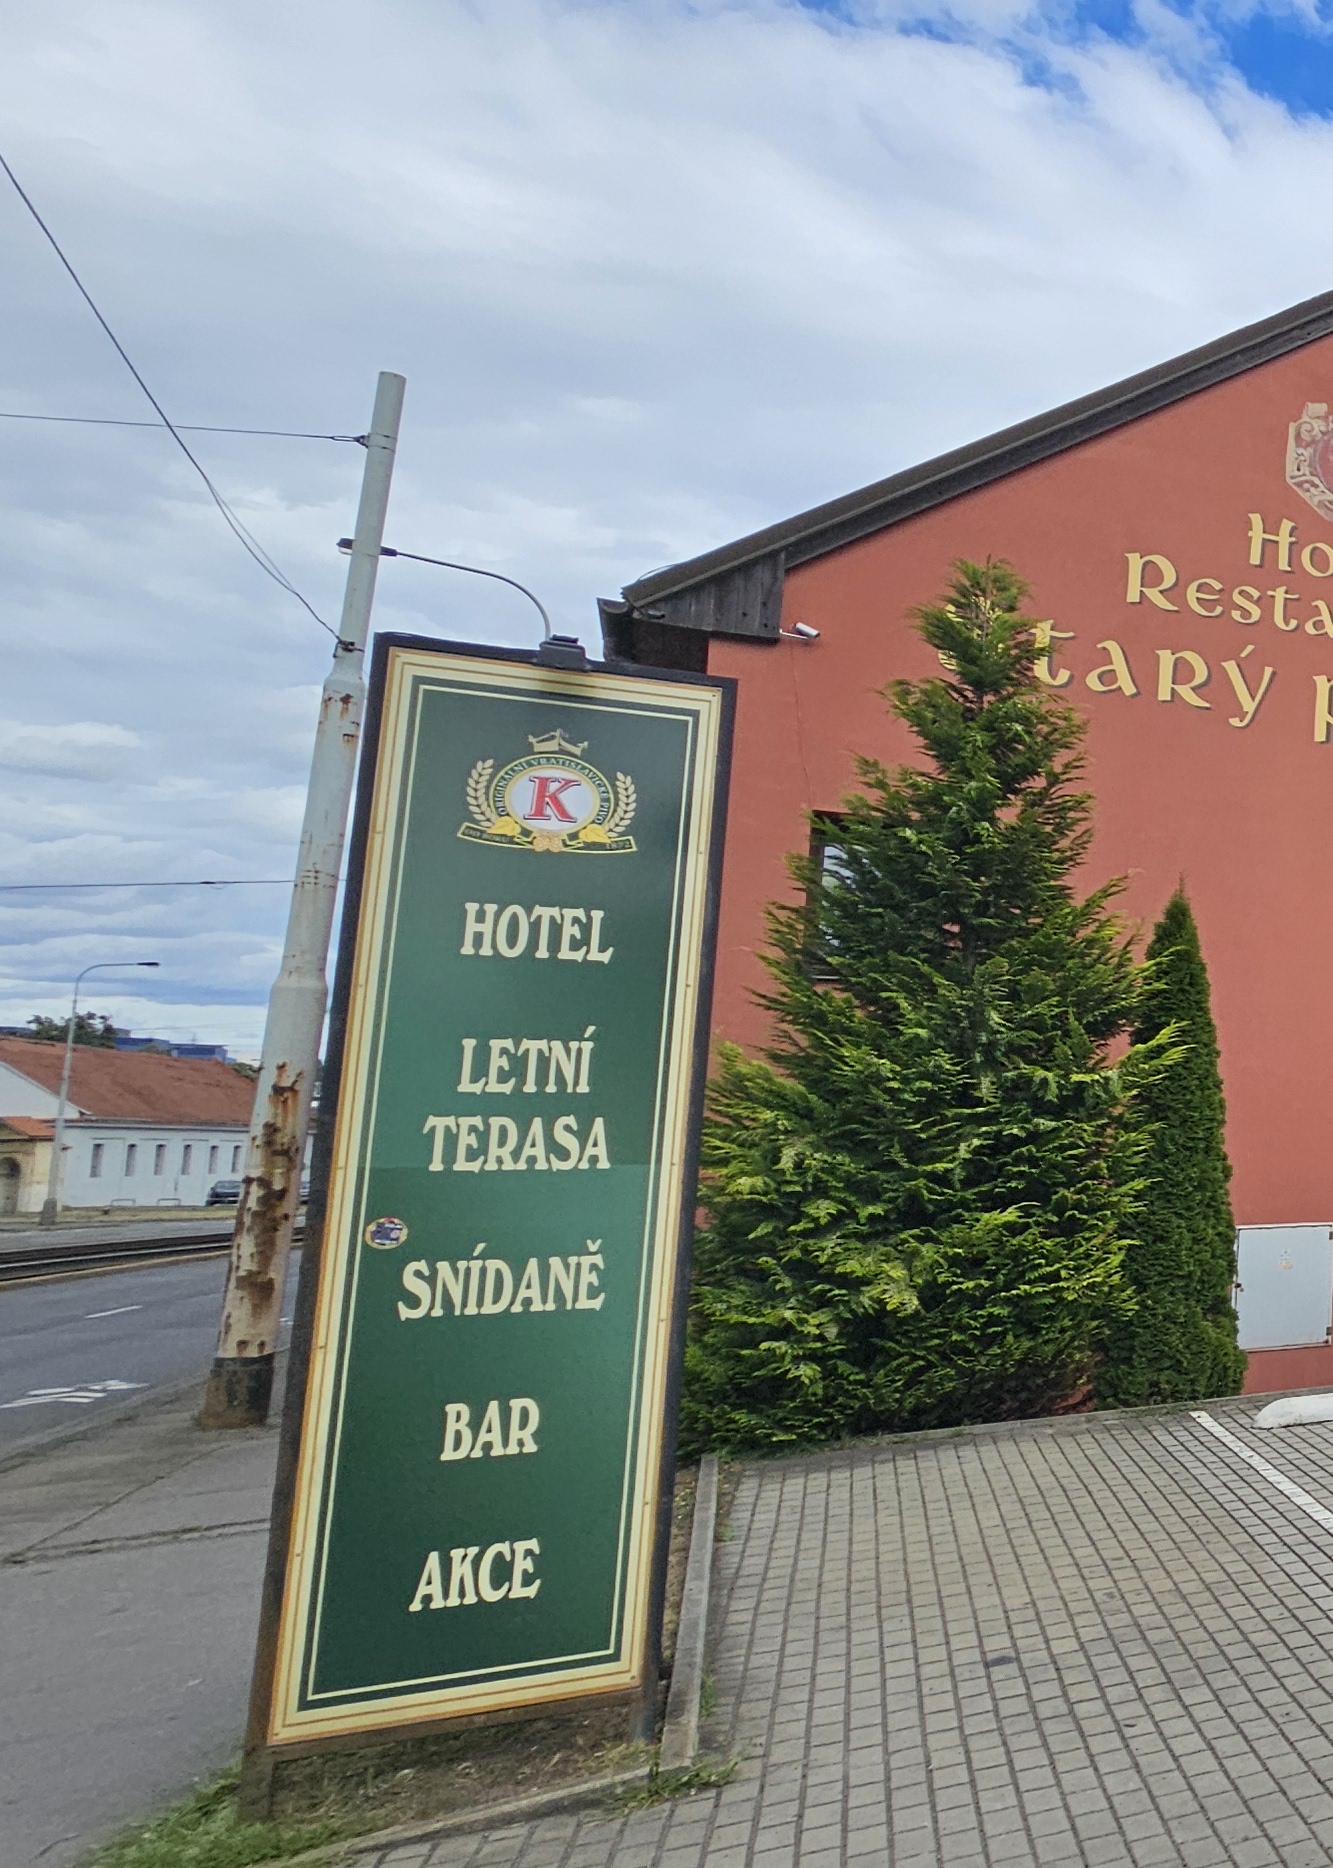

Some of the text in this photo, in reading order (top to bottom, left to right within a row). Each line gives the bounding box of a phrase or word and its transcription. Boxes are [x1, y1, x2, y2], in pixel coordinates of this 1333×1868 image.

[523, 775, 582, 823] K
[594, 802, 609, 823] PIVO
[460, 902, 614, 964] HOTEL
[457, 1026, 596, 1094] LETNÍ
[422, 1115, 611, 1173] TERASA
[398, 1239, 605, 1321] SNÍDANĚ
[440, 1398, 540, 1462] BAR
[409, 1538, 541, 1613] AKCE
